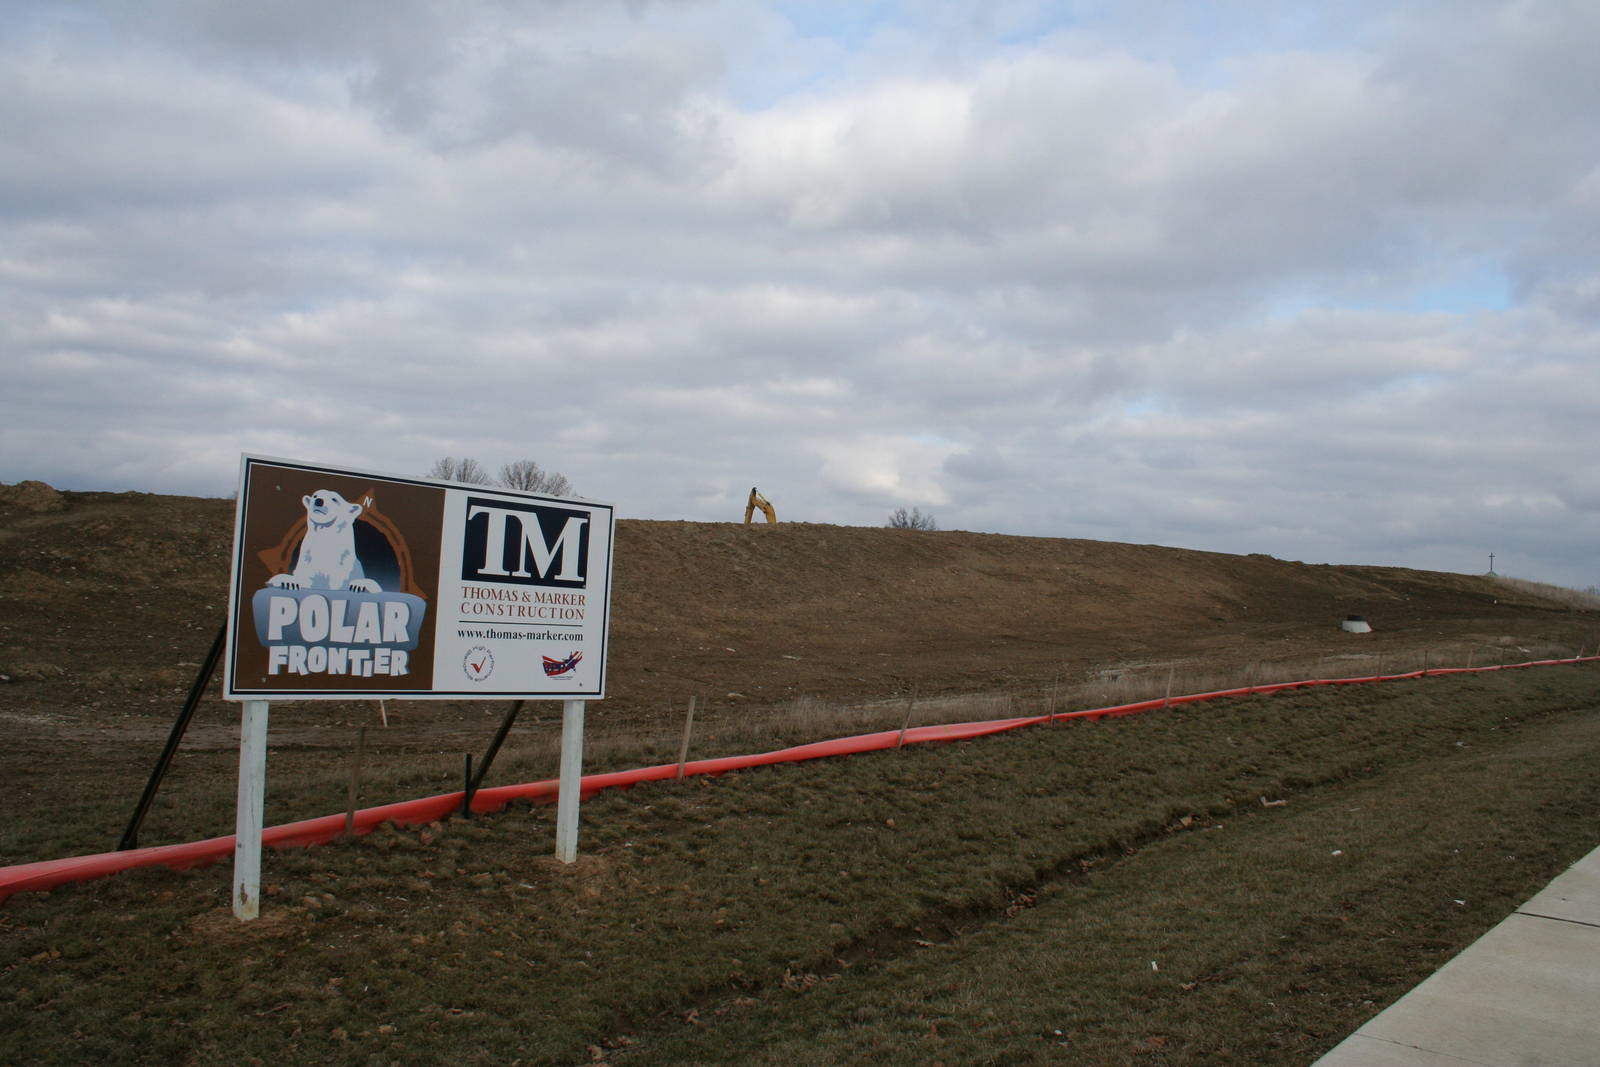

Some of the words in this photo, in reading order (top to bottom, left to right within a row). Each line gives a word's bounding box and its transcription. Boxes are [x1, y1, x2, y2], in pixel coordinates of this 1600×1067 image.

[363, 495, 373, 508] N
[468, 505, 588, 582] TM
[461, 586, 518, 602] THOMAS
[521, 591, 531, 603] &
[534, 591, 586, 606] MARKER
[268, 594, 410, 644] POLAR
[461, 602, 584, 620] CONSTRUCTION
[457, 628, 584, 641] www.thomas-marker.com
